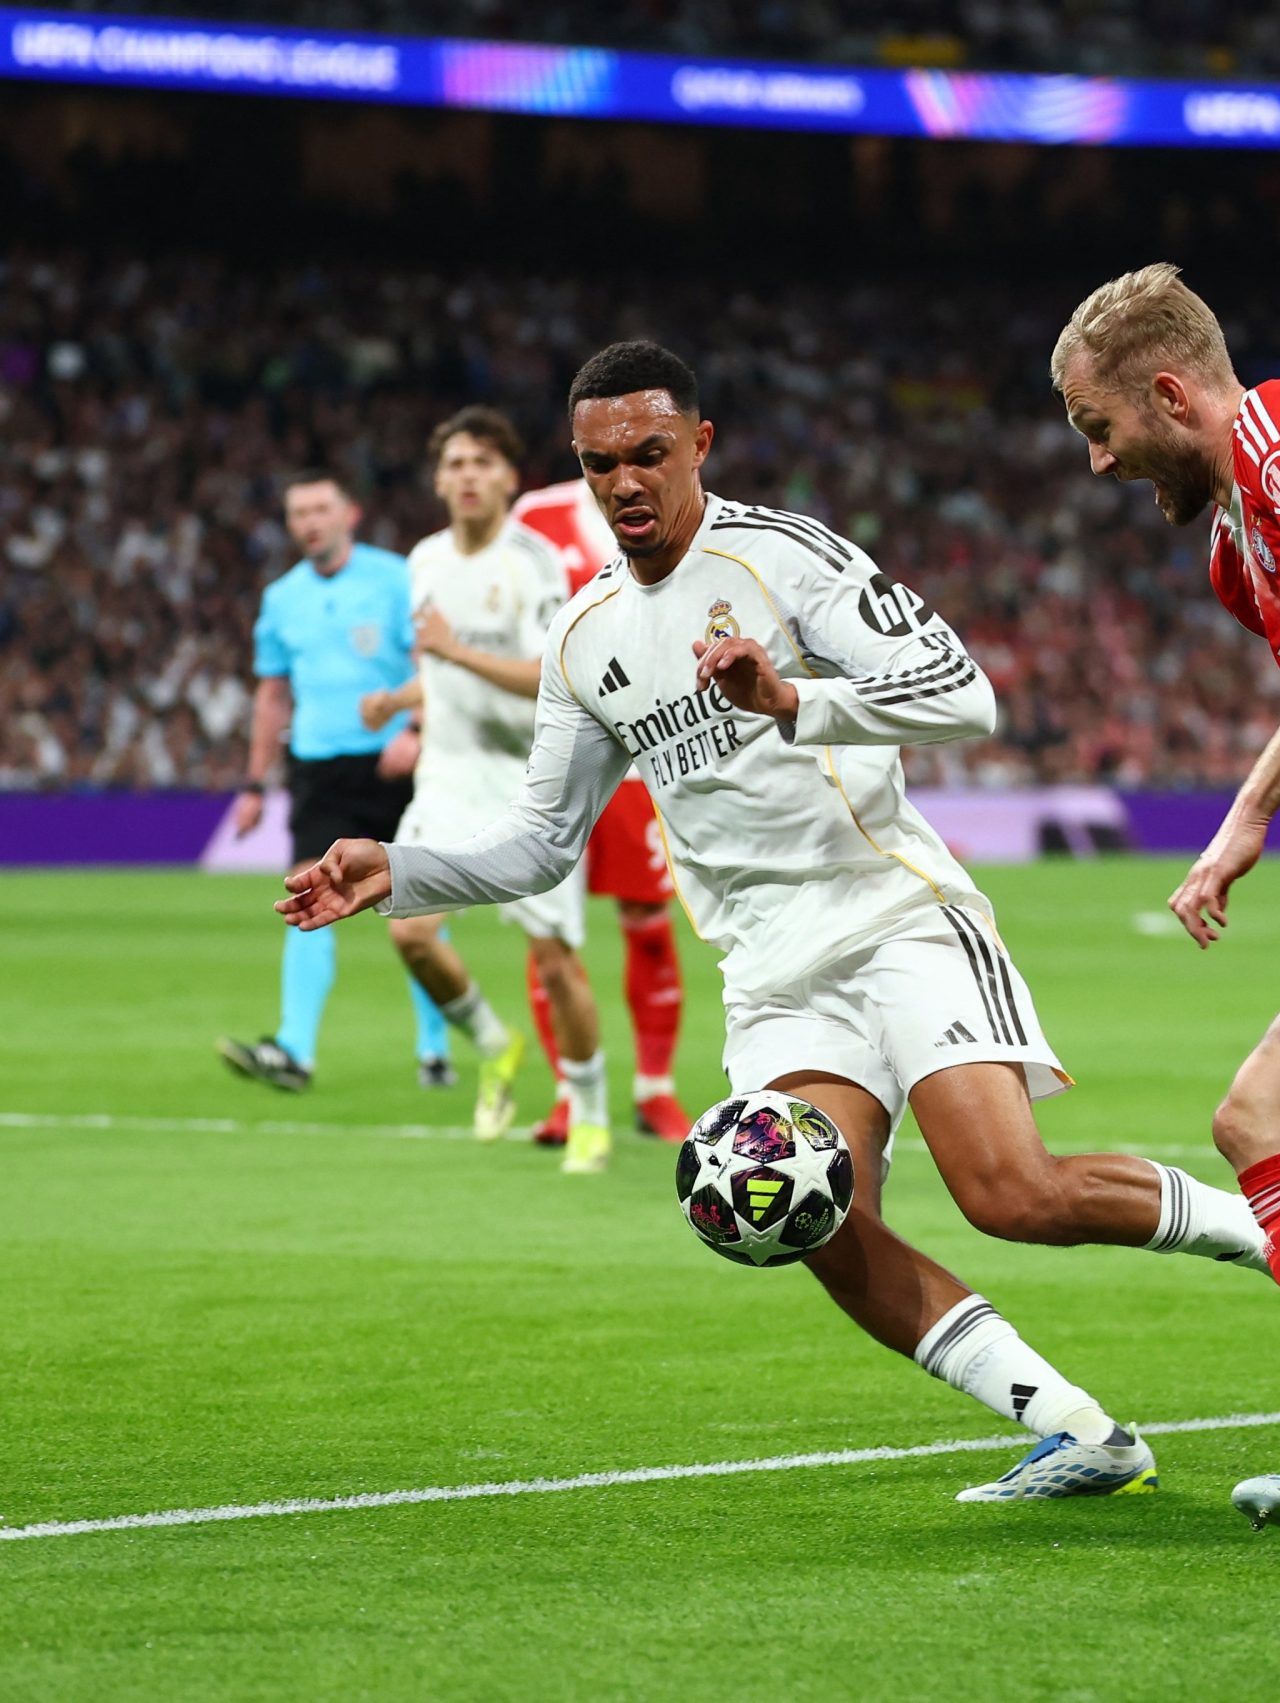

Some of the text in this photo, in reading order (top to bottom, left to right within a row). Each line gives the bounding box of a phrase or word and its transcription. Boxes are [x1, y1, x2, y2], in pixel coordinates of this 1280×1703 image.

[97, 25, 280, 83] CHAMPIONS
[281, 39, 398, 91] LEAGUE
[861, 574, 936, 637] hp
[614, 682, 733, 758] Emirate
[650, 719, 743, 789] FLY BETTER
